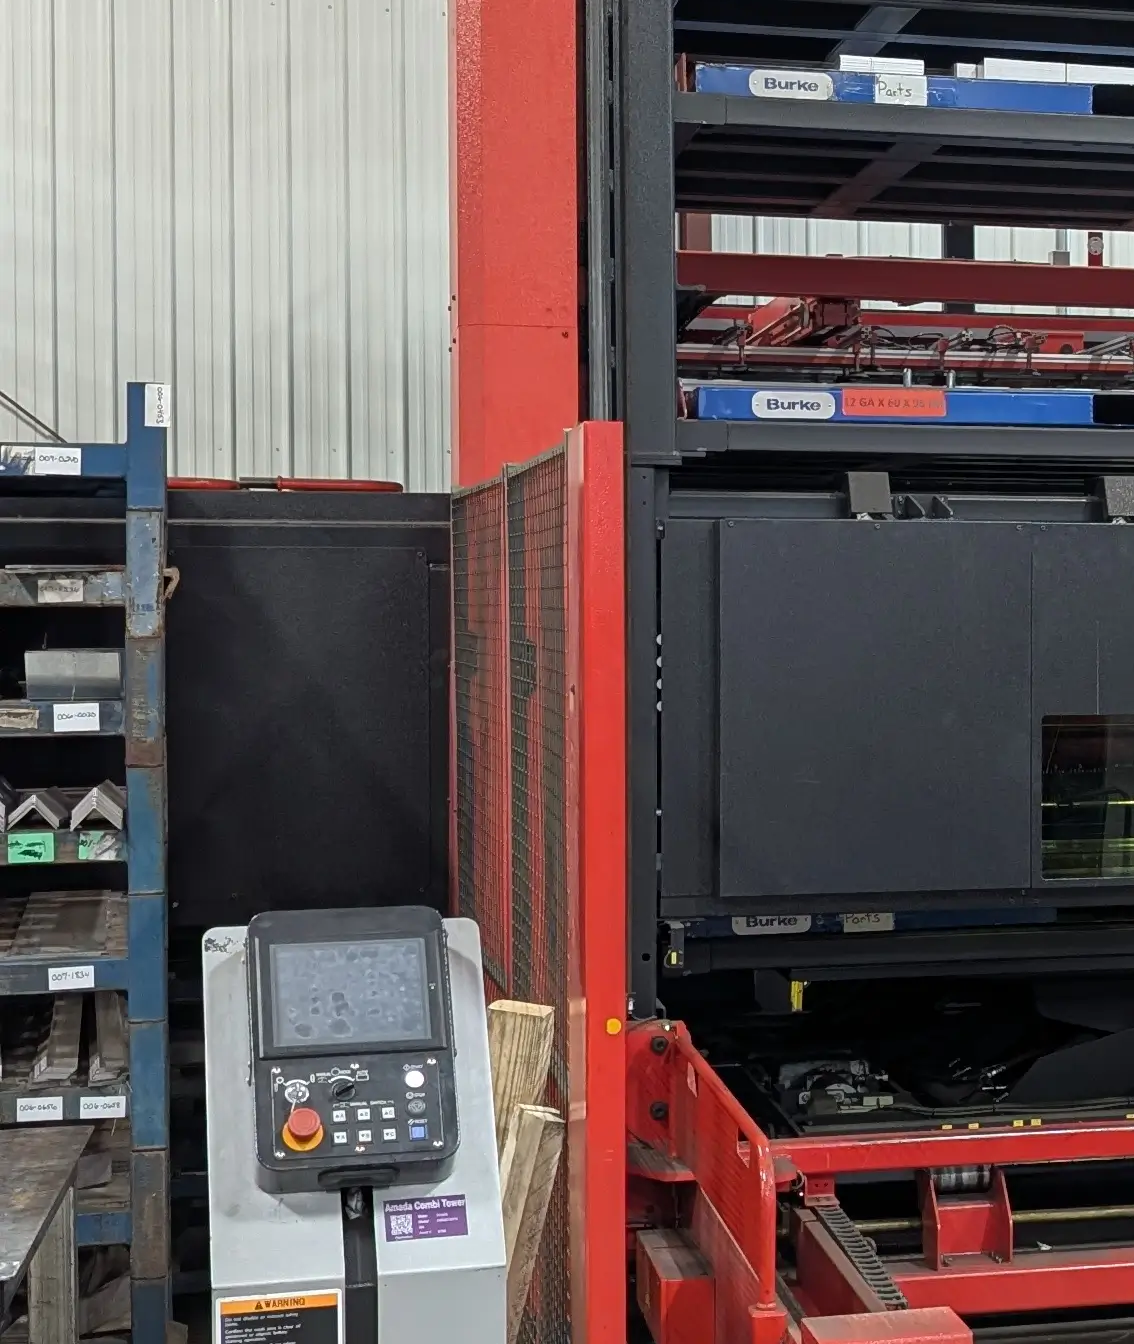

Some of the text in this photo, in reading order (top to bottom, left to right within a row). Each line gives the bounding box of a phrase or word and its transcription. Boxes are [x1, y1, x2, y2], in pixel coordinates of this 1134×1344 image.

[763, 77, 819, 93] Burke
[877, 77, 913, 98] Parts
[766, 398, 822, 412] Burke
[859, 397, 875, 407] GA
[878, 397, 885, 408] X
[746, 915, 798, 928] Burke
[414, 1199, 440, 1210] Combi
[441, 1198, 465, 1208] Tower
[264, 1297, 305, 1308] WARNING
